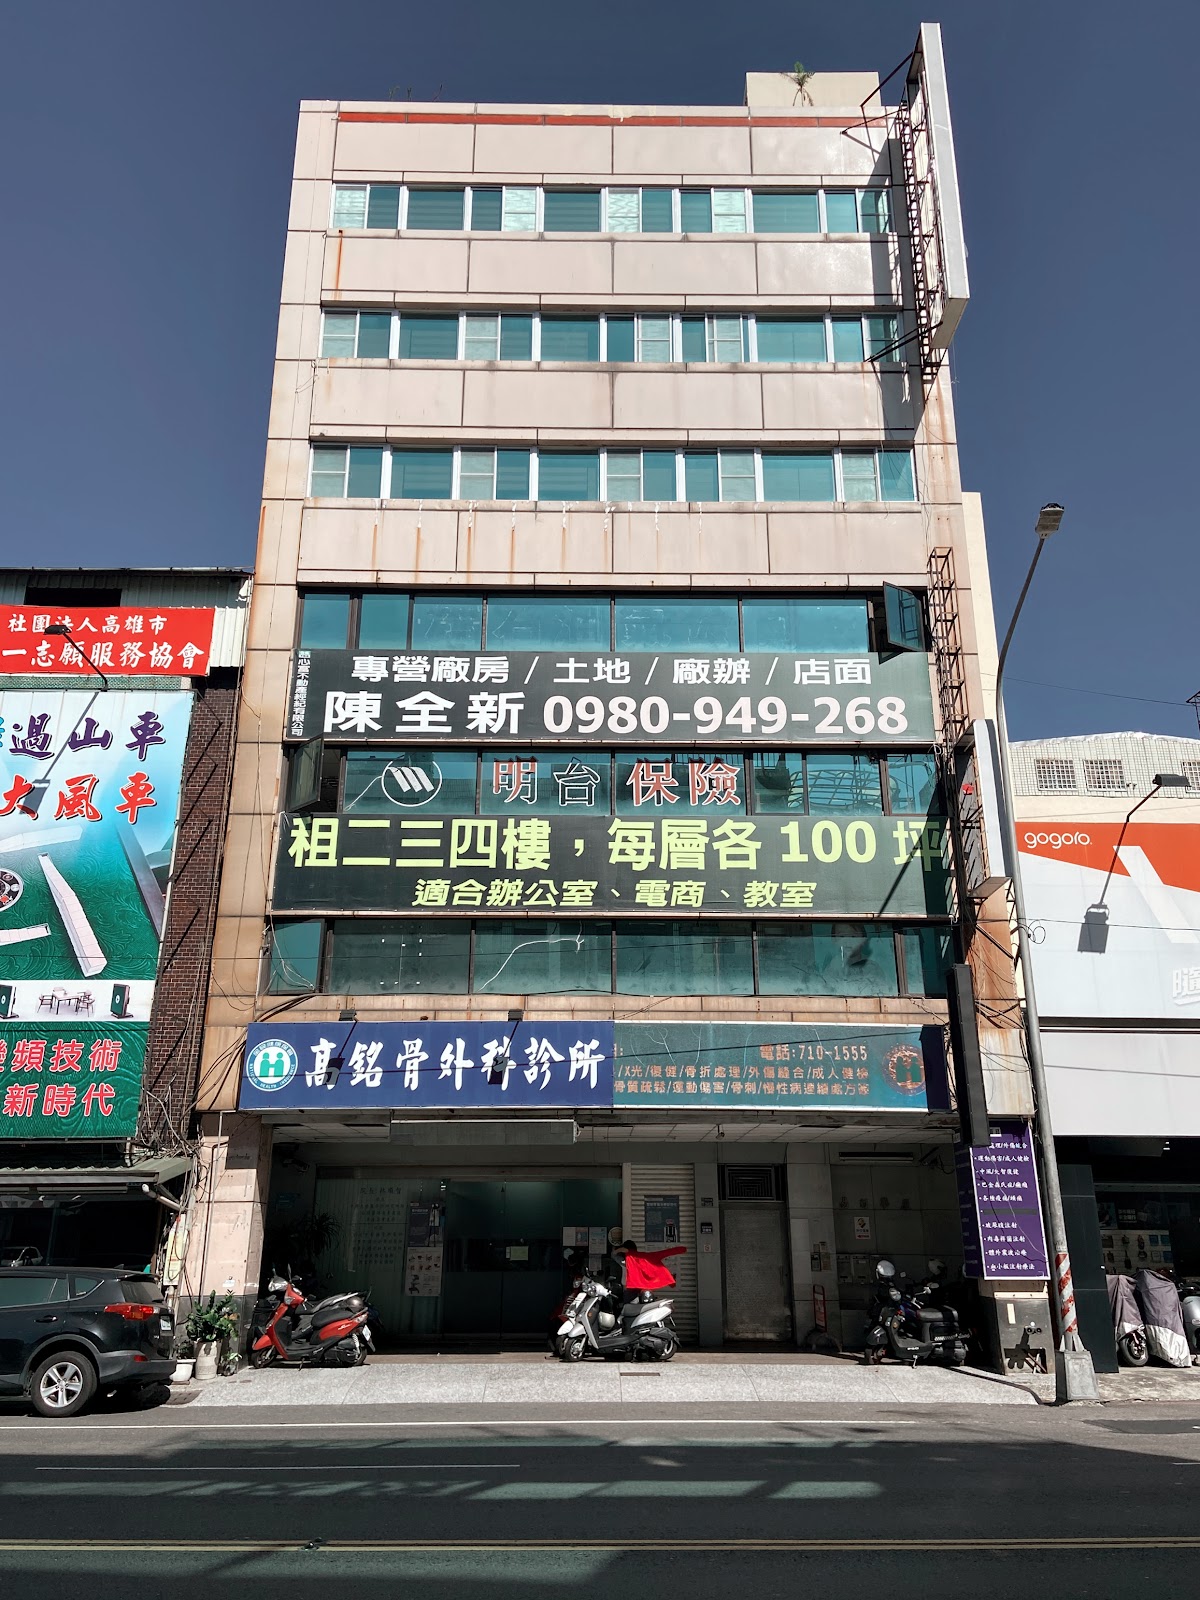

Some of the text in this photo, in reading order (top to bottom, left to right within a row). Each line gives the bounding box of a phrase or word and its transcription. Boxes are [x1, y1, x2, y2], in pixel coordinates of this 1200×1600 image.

[2, 639, 205, 670] 一志願服務協會
[352, 655, 511, 684] 專營廠房
[553, 657, 631, 684] 土地
[672, 657, 751, 685] 廠辦
[793, 657, 872, 685] 店面
[323, 690, 909, 735] 陳全新 0980-949-268
[0, 711, 166, 761] 過山車
[0, 772, 157, 824] 大風車
[493, 756, 742, 806] 明台保險
[1024, 831, 1090, 850] gogoro
[0, 1039, 122, 1073] 頻技術
[304, 1036, 606, 1091] 高銘骨外科診所
[3, 1083, 117, 1118] 新時代
